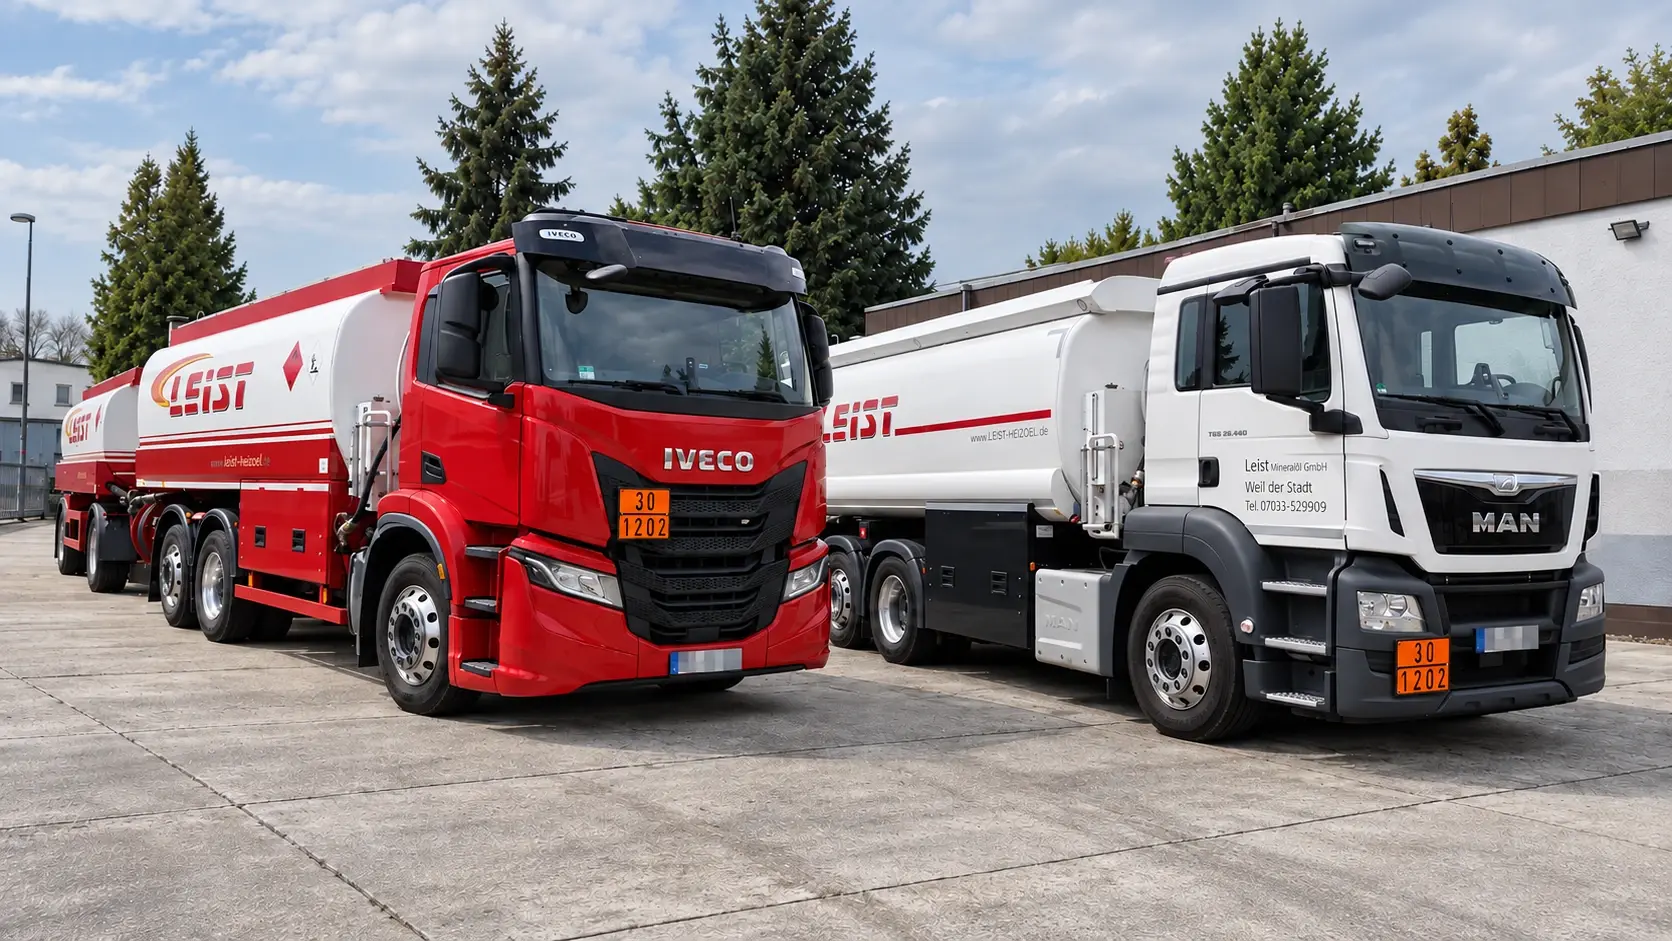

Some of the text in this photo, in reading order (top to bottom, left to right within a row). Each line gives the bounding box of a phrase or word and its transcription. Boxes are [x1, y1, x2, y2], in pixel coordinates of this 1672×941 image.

[547, 231, 577, 239] IVECO
[664, 447, 754, 472] IVECO
[1245, 458, 1270, 472] Leist
[1303, 462, 1328, 472] GmbH
[1245, 481, 1313, 493] Weil der Stadt
[635, 491, 655, 511] 30
[1245, 500, 1327, 512] Tel. 07033-529909
[623, 517, 666, 537] 1202
[1472, 511, 1540, 533] MAN
[1414, 641, 1434, 664] 30
[1401, 667, 1446, 692] 1202
